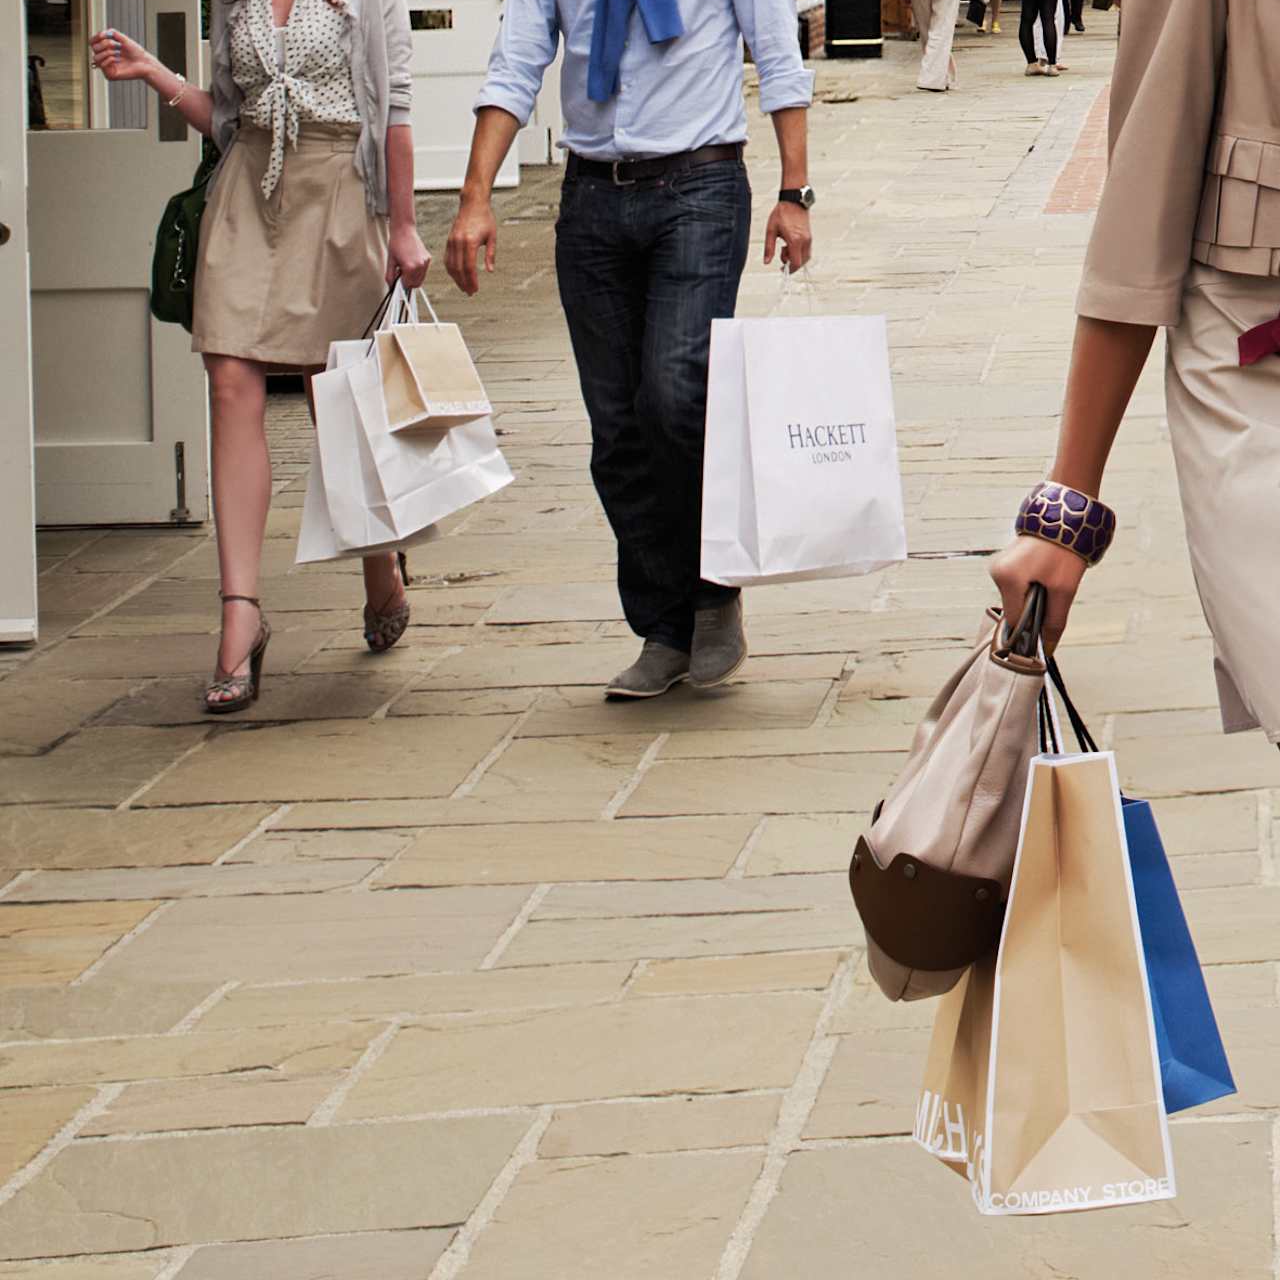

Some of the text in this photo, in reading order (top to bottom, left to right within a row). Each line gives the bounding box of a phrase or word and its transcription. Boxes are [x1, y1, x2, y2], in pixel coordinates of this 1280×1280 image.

[787, 422, 866, 449] HACKETT
[811, 450, 852, 465] LONDON
[990, 1176, 1170, 1210] COMPANY STORE
